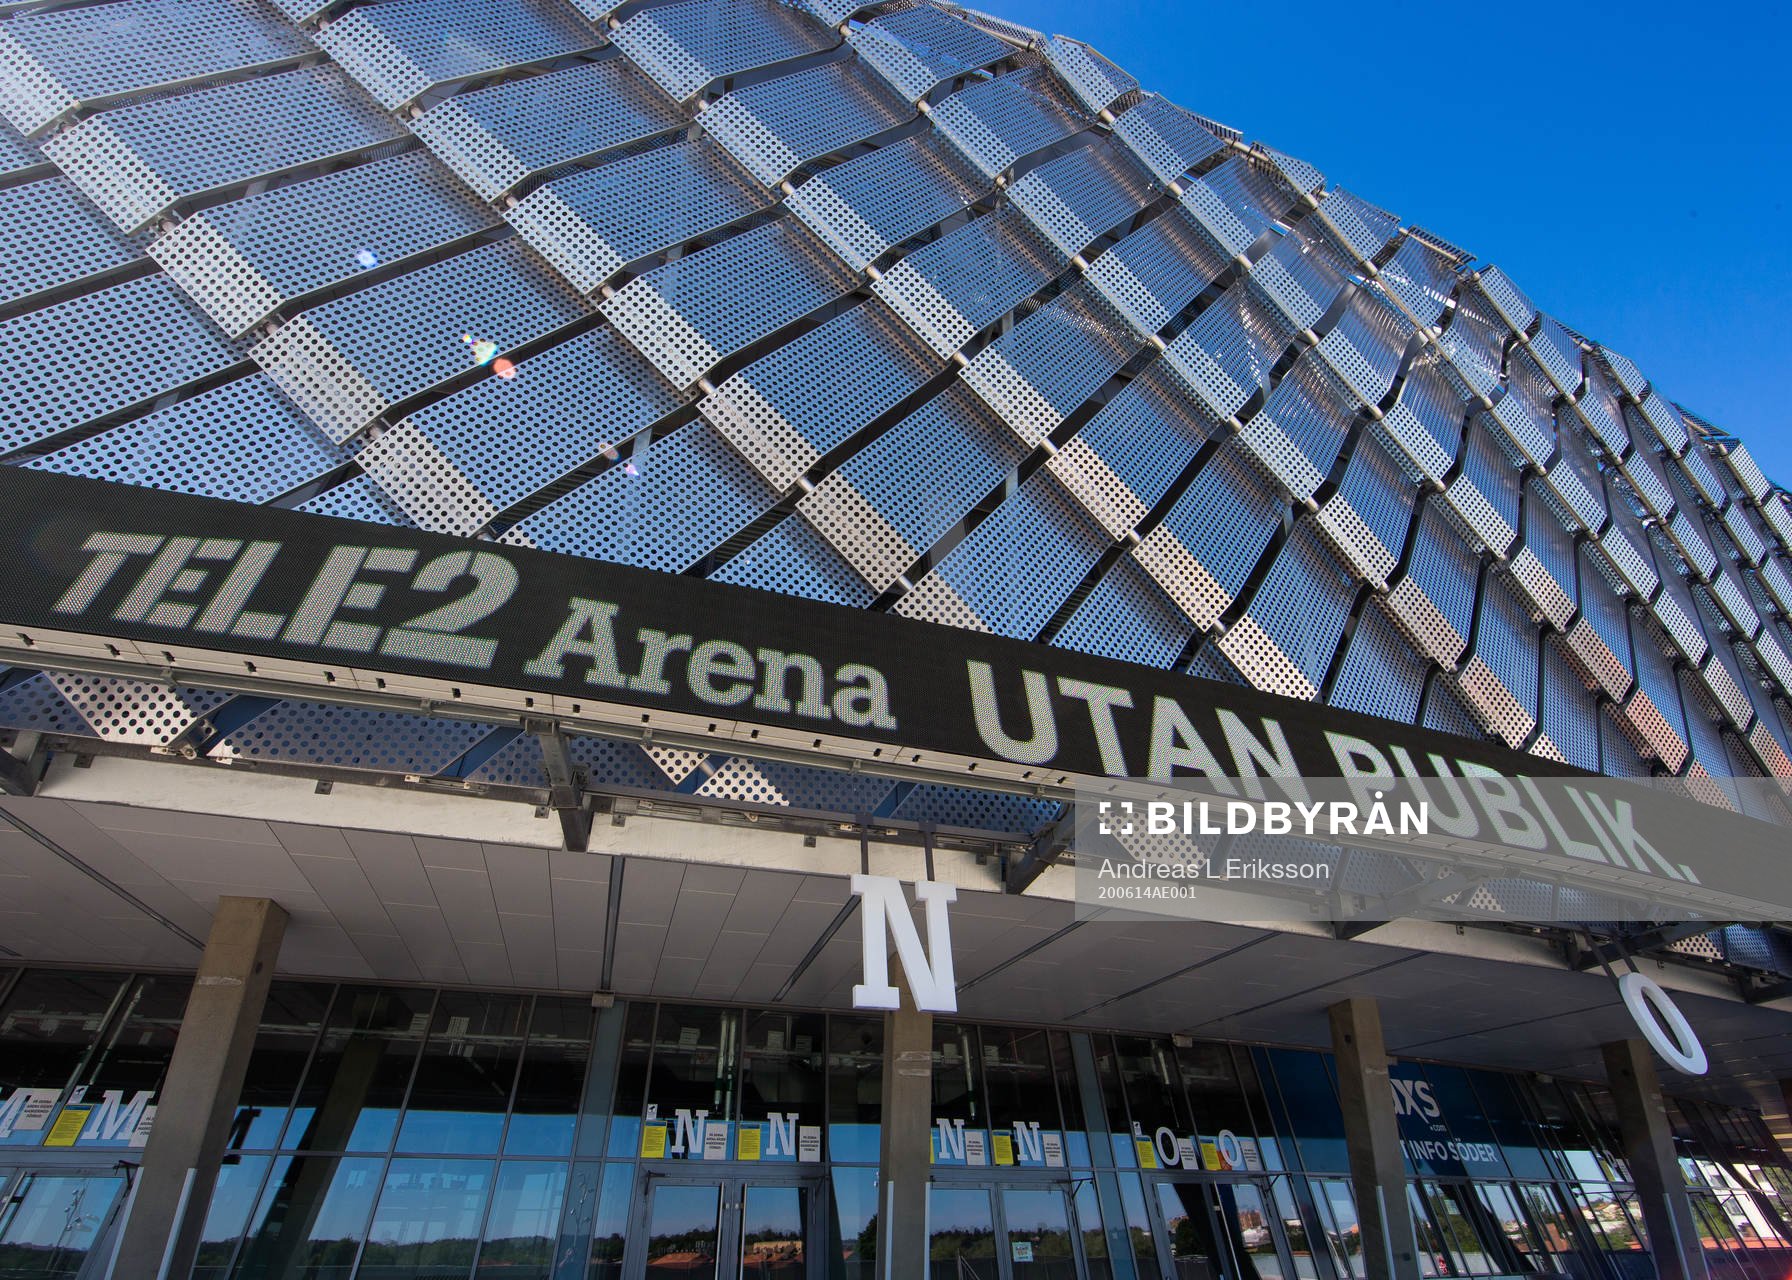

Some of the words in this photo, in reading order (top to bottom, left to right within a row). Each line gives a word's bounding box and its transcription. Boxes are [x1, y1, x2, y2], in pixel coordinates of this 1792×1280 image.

[50, 531, 519, 669] TELE2
[523, 596, 898, 730] Arena
[966, 659, 1313, 809] UTAN
[1323, 730, 1701, 884] PUBLIK.
[850, 874, 957, 1013] N
[1619, 972, 1708, 1075] O
[80, 1090, 156, 1140] M
[671, 1108, 709, 1154] N
[766, 1112, 799, 1156] N
[936, 1118, 965, 1160] N
[1013, 1121, 1042, 1162] N
[1156, 1126, 1180, 1166] O
[1218, 1129, 1243, 1167] O
[1409, 1139, 1448, 1161] INFO
[1447, 1138, 1498, 1162] SÖDER
